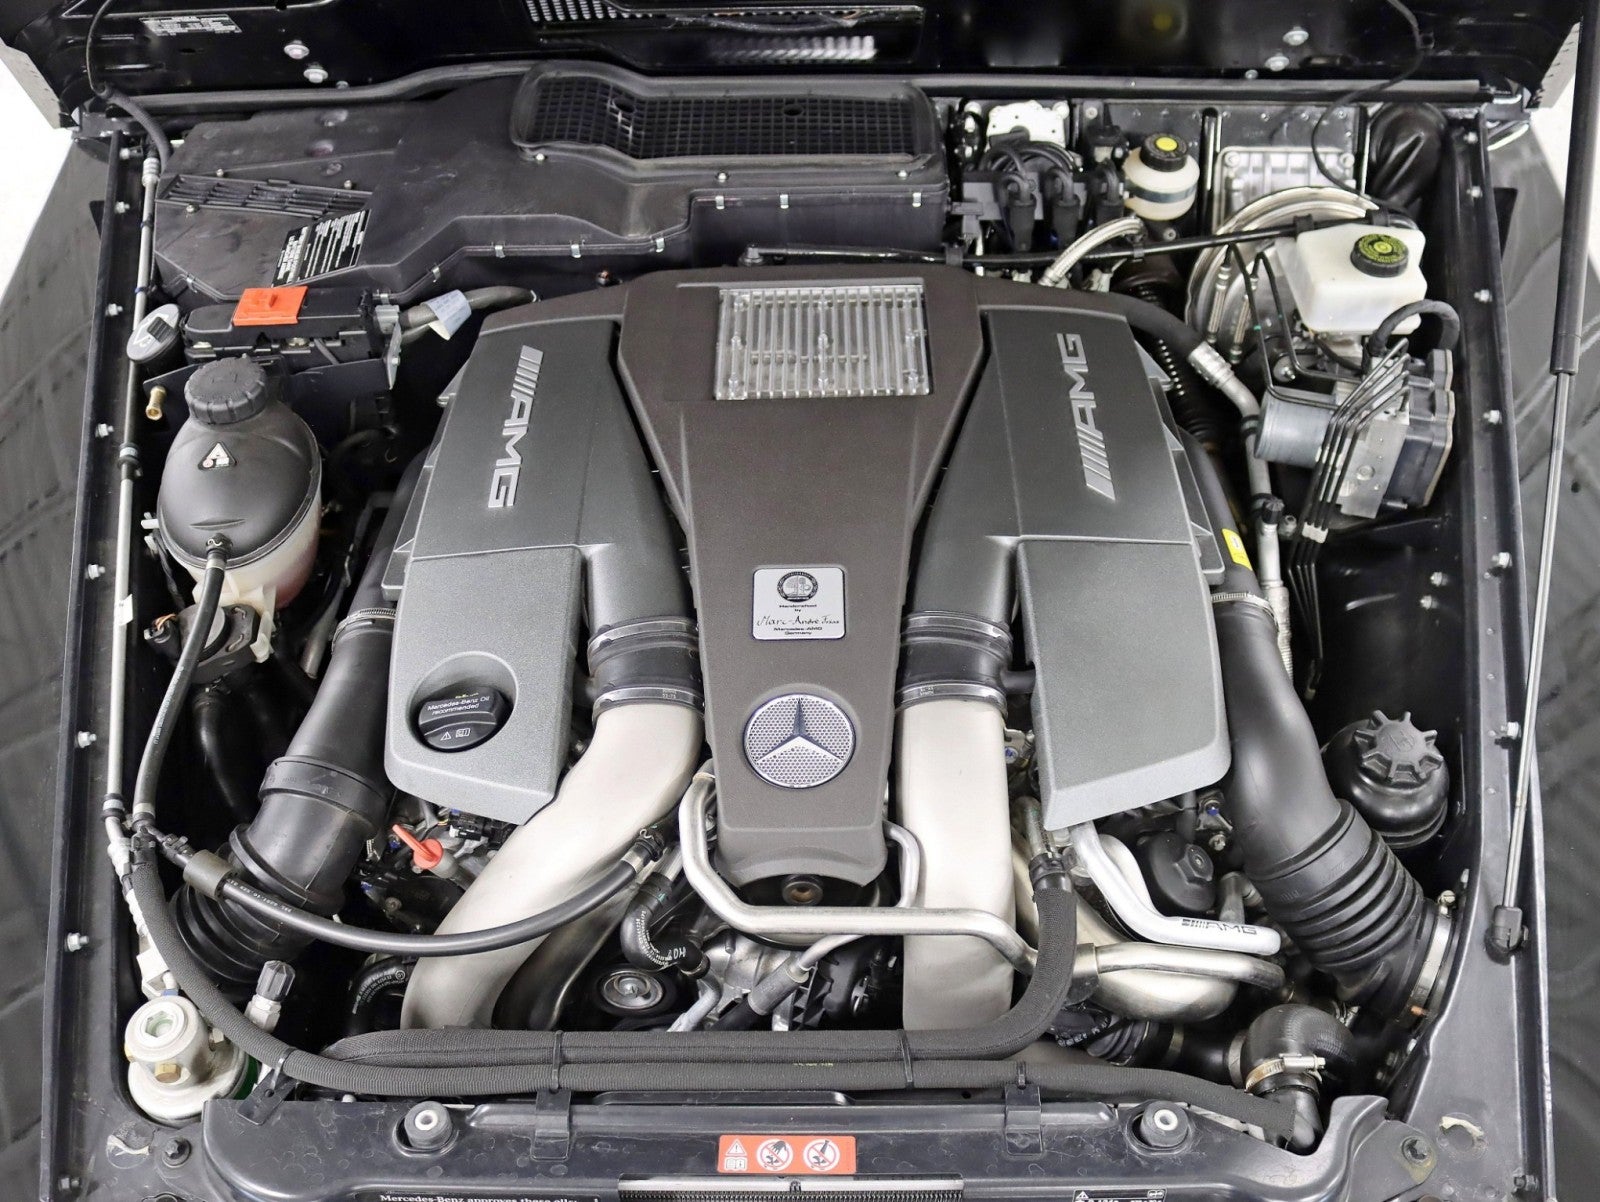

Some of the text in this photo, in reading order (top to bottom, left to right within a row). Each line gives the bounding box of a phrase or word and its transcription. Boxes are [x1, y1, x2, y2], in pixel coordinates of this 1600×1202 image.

[1056, 333, 1104, 442] AMG
[488, 389, 533, 508] AMG
[427, 697, 480, 712] Mercedes-Benz
[431, 703, 480, 716] recommended
[1204, 921, 1258, 936] AMG
